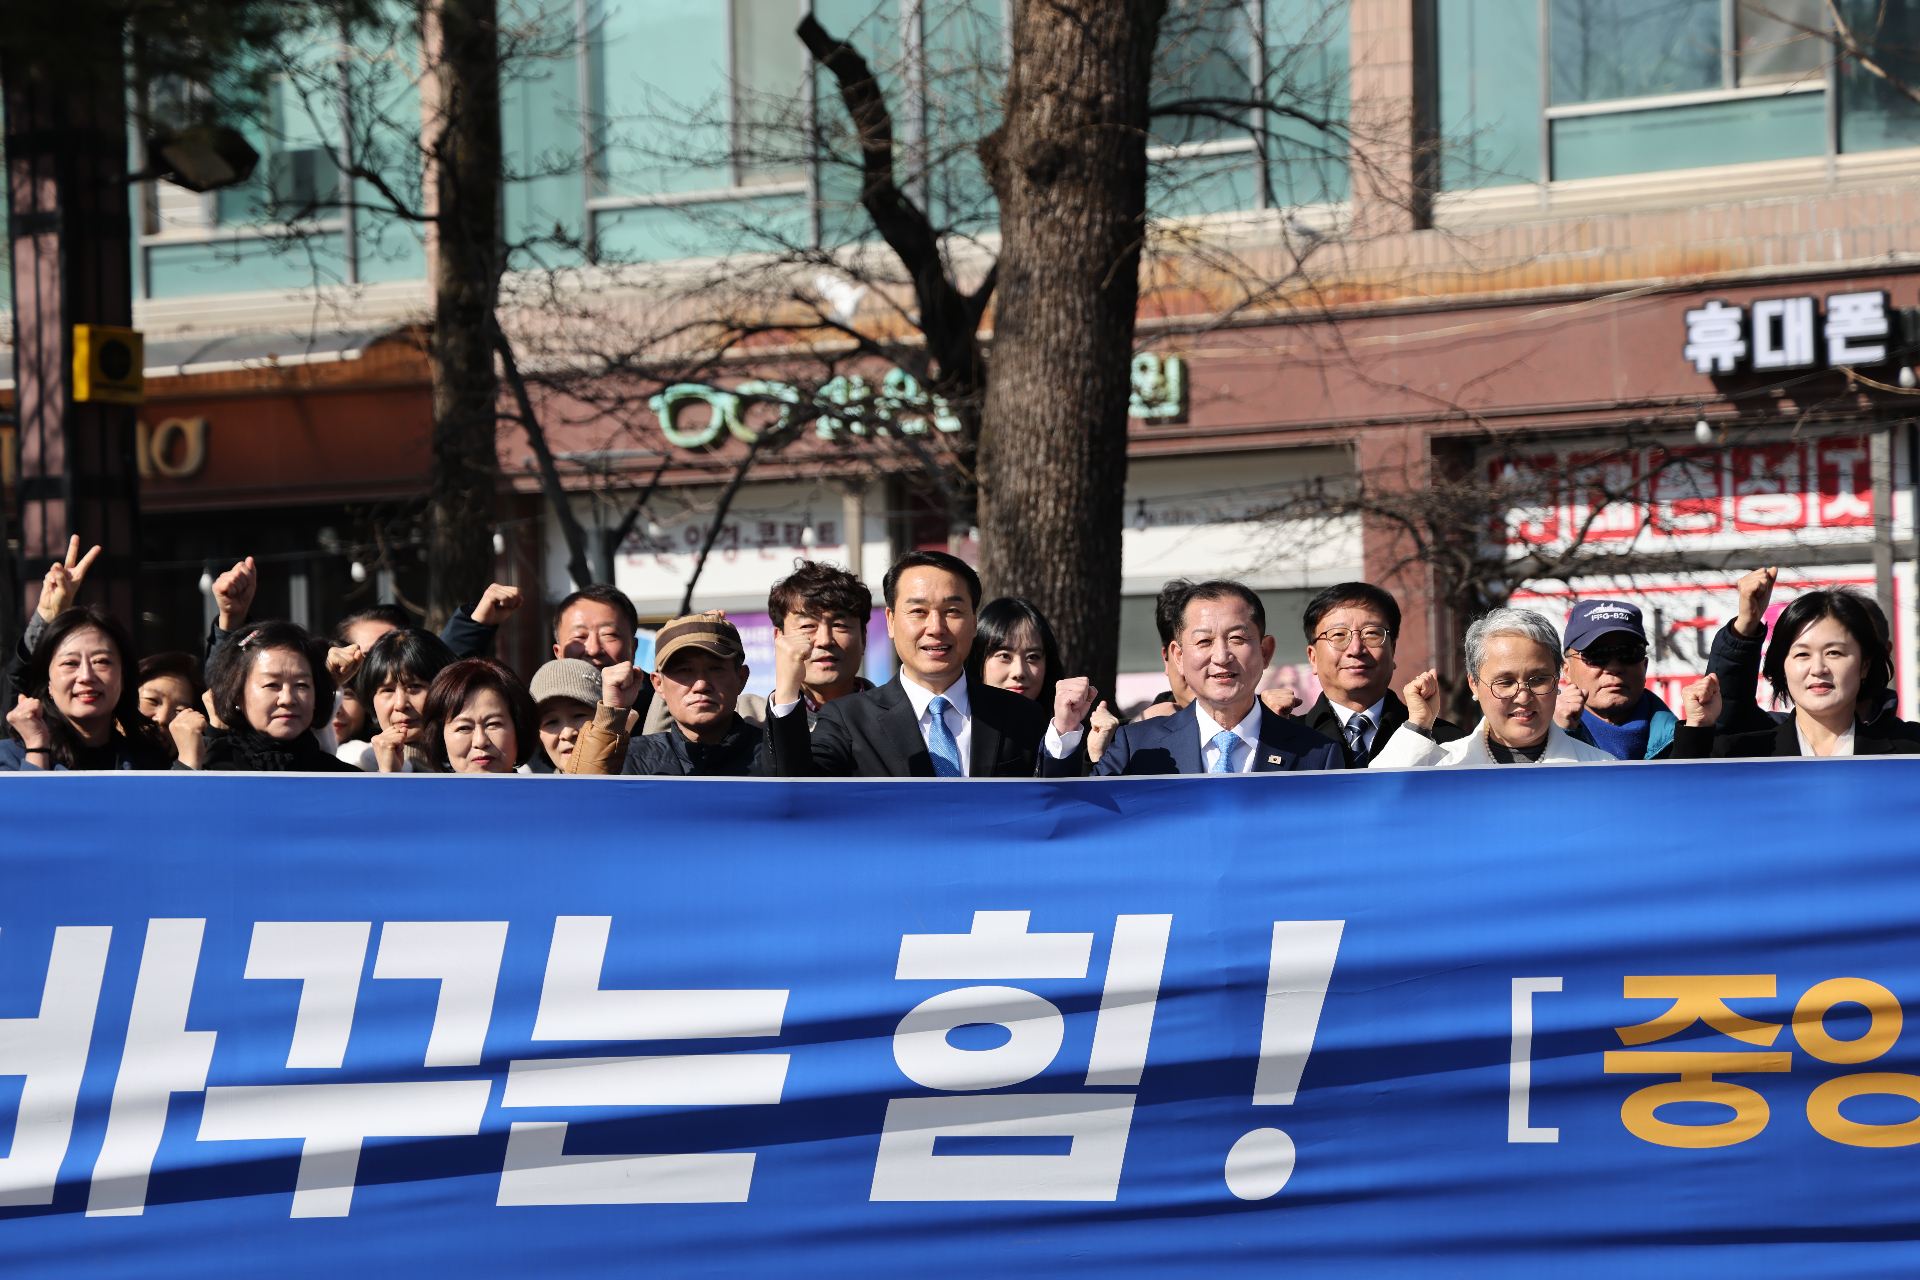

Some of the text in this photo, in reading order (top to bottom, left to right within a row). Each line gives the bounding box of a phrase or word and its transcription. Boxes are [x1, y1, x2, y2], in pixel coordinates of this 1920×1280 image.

[1684, 291, 1889, 373] 휴대폰
[1654, 605, 1719, 664] kt
[869, 910, 1346, 1202] 힘!
